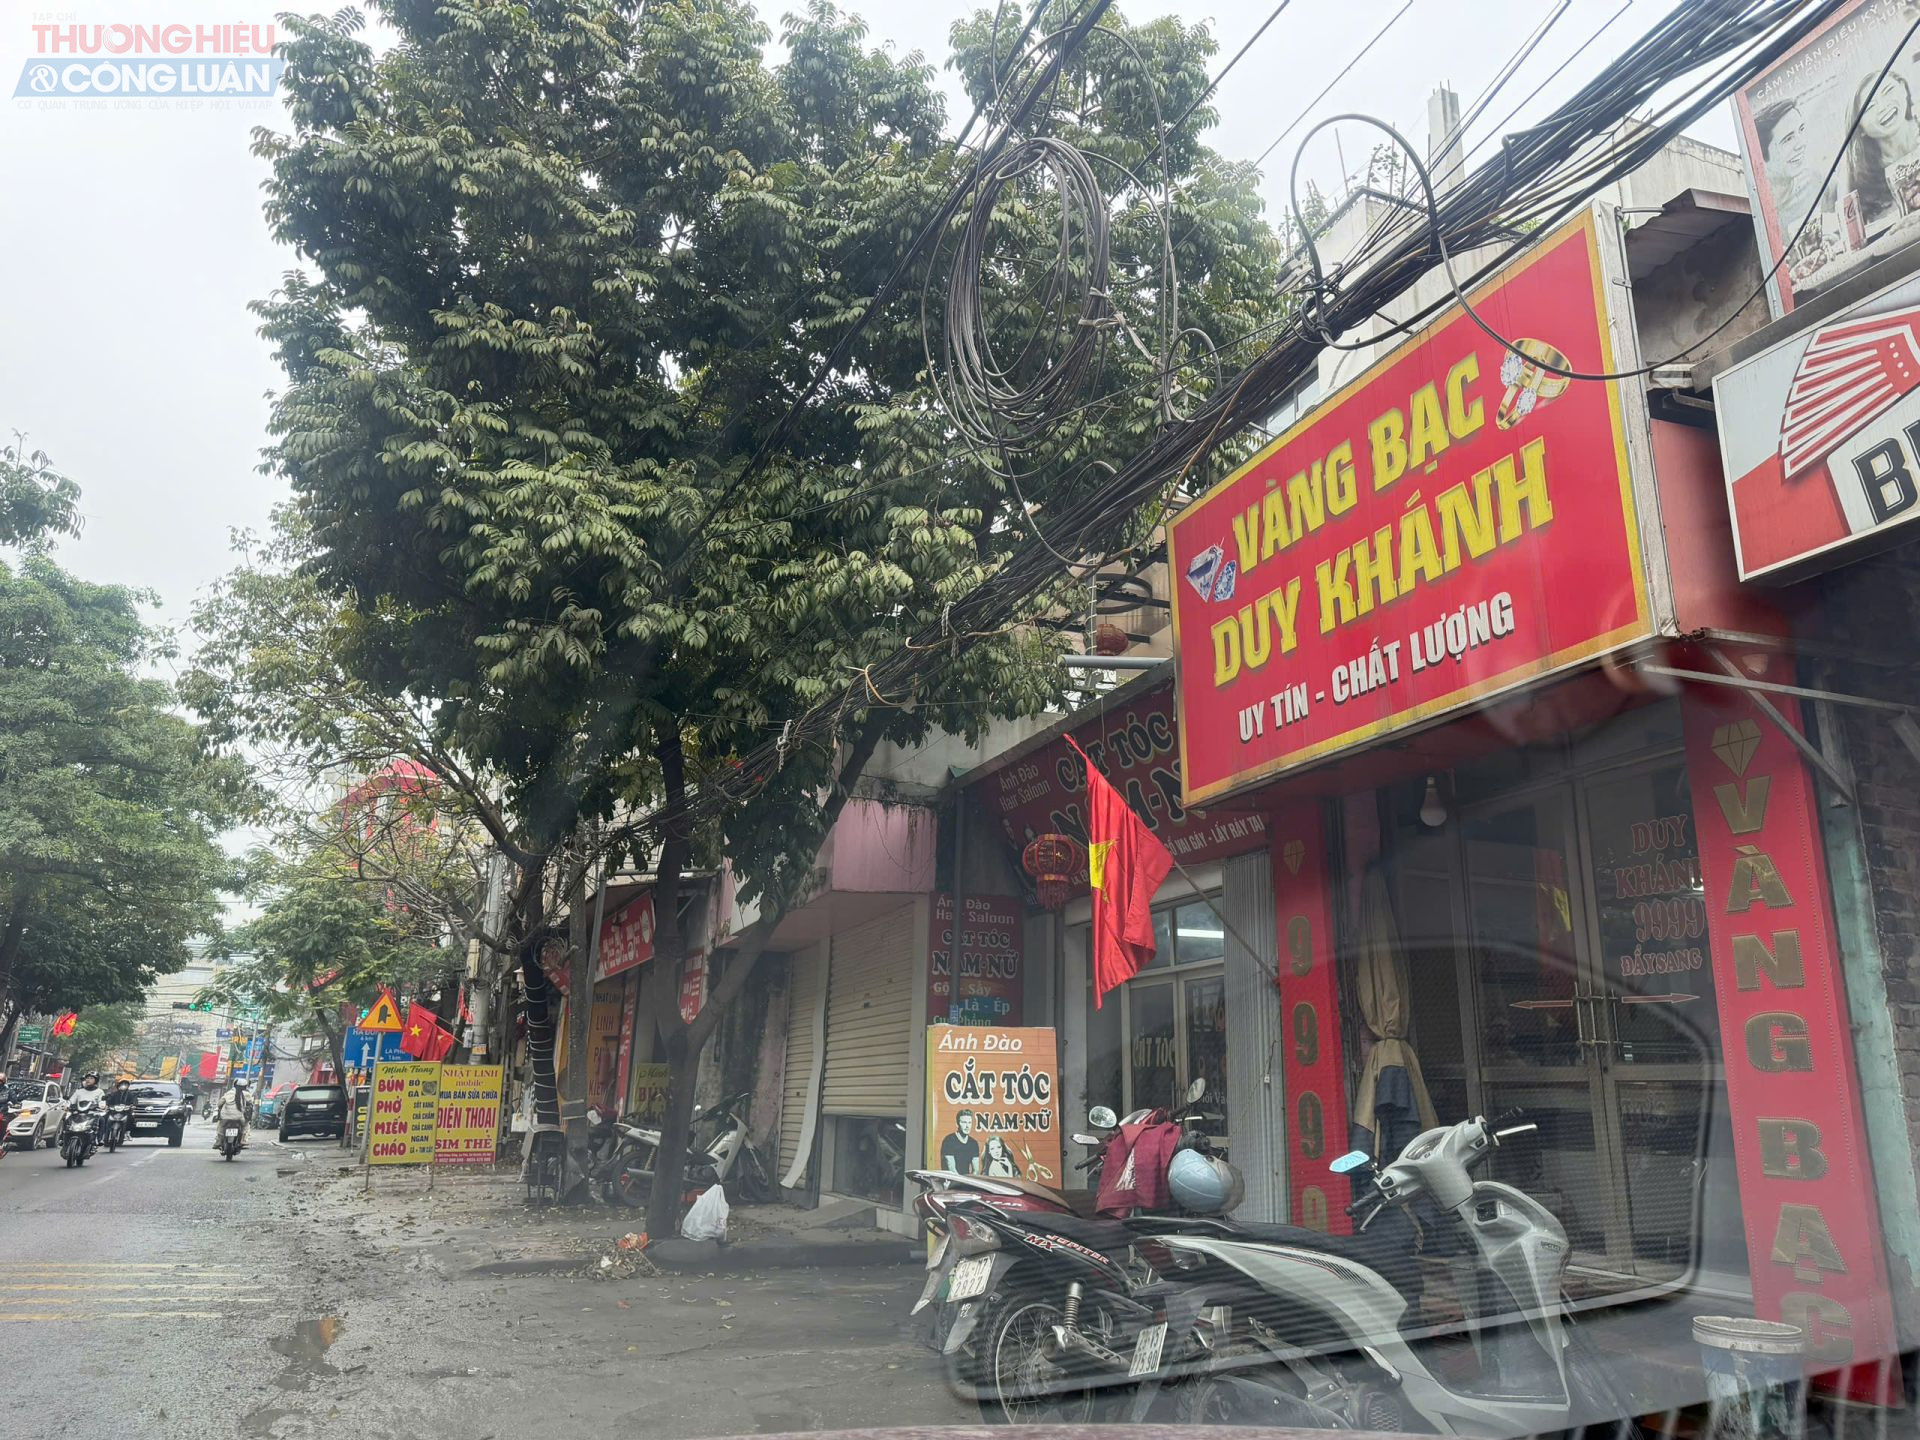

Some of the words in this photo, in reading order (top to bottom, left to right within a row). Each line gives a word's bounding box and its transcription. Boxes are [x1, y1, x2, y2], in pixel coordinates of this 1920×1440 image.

[1232, 438, 1357, 577] VÀNG
[1367, 351, 1487, 493] BẠC
[1211, 578, 1302, 689] DUY
[1314, 434, 1555, 636] KHÁNH
[1238, 700, 1266, 742] UY
[1271, 682, 1309, 729] TÍN
[1331, 635, 1403, 705] CHẤT
[1410, 591, 1517, 670] LƯỢNG
[1109, 711, 1174, 769] TÓC
[1247, 814, 1266, 833] TAI
[1631, 813, 1688, 854] DUY
[966, 898, 991, 911] Đào
[968, 911, 1015, 925] Saloon
[1633, 897, 1704, 943] 9999
[977, 928, 1011, 948] TÓC
[938, 1030, 978, 1051] Ánh
[983, 1033, 1023, 1051] Đào
[473, 1069, 498, 1077] LINH
[944, 1056, 996, 1104] CẮT
[1000, 1063, 1051, 1104] TÓC
[378, 1075, 405, 1093] BÚN
[376, 1095, 402, 1113] PHỞ
[374, 1116, 408, 1135] MIẾN
[465, 1106, 497, 1134] THOẠI
[373, 1138, 407, 1156] CHÁO
